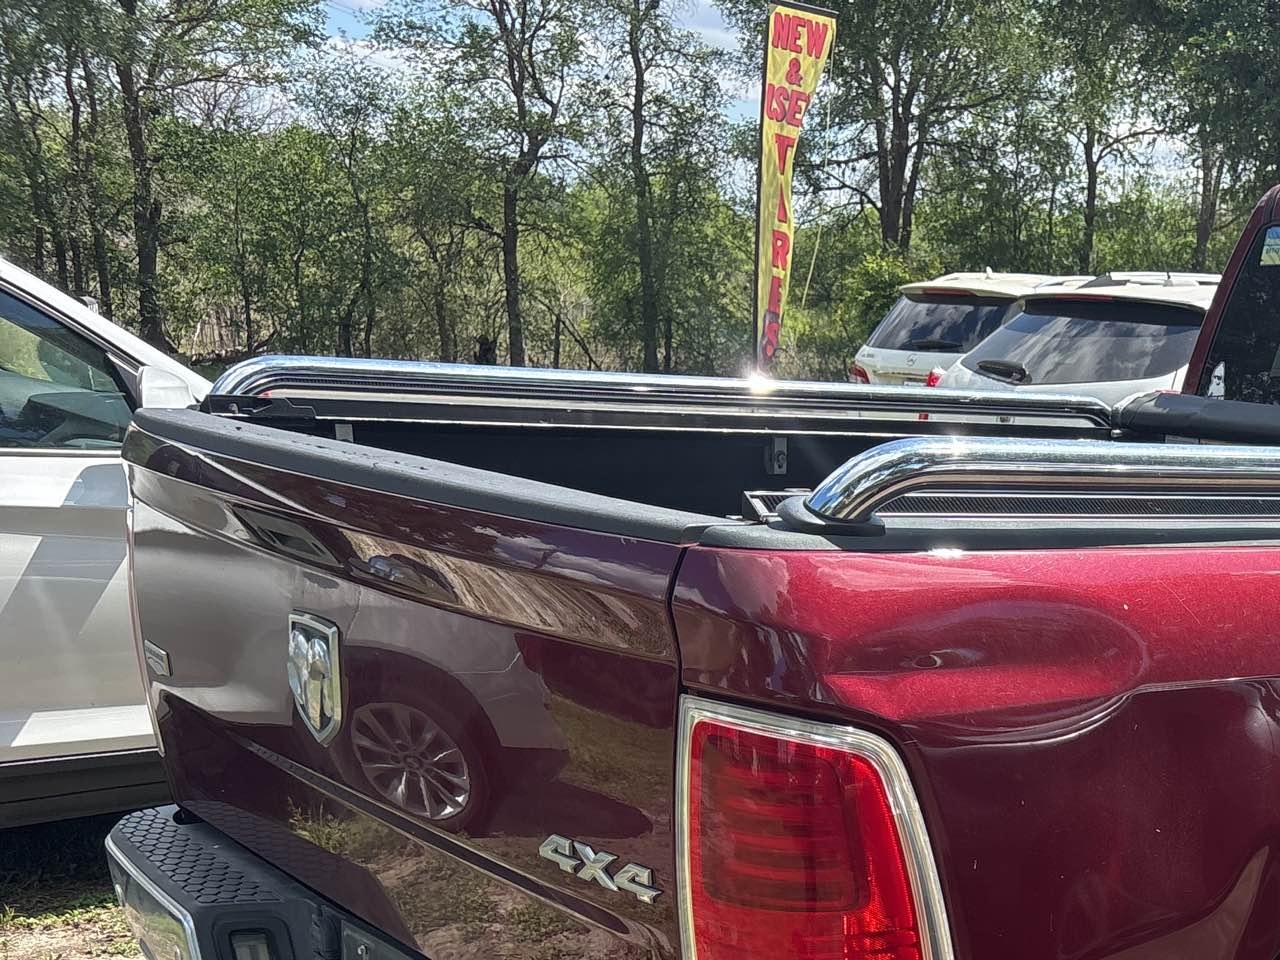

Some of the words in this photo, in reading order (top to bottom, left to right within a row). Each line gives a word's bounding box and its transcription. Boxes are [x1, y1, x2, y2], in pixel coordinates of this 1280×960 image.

[771, 11, 829, 59] NEW
[785, 57, 803, 87] &
[766, 84, 811, 128] SE
